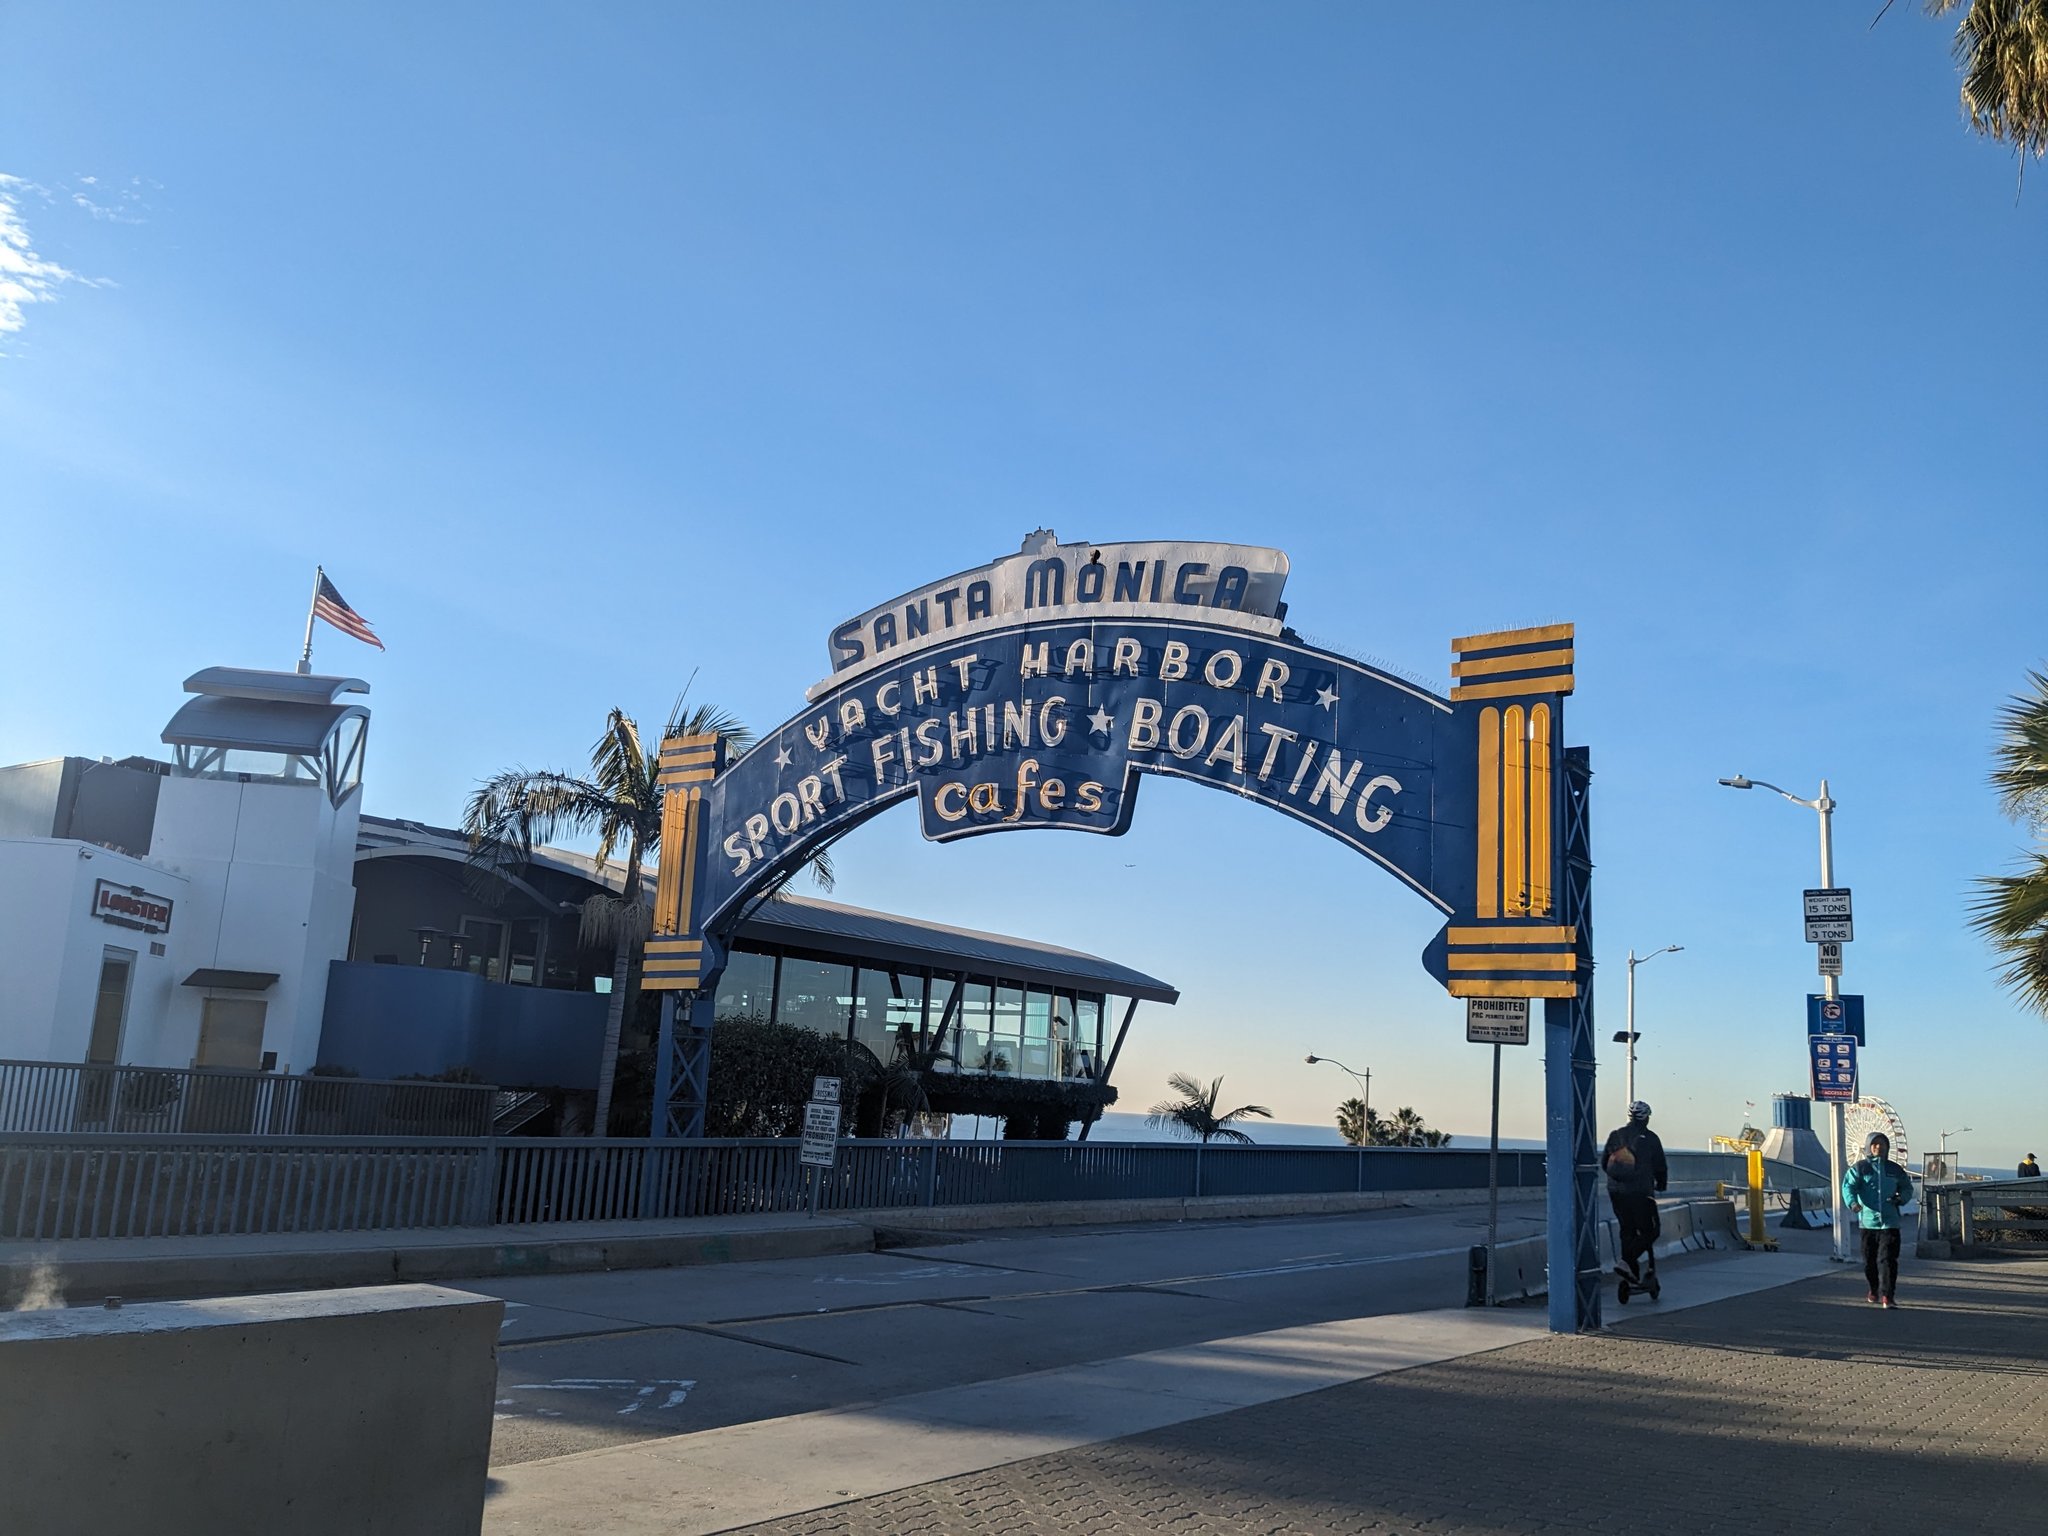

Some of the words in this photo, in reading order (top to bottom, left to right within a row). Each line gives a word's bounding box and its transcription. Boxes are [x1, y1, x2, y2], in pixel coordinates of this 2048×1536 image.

[833, 580, 991, 671] SANTA
[1025, 557, 1248, 609] MONICA
[805, 654, 977, 752] YACHT
[1021, 637, 1290, 703] HARBOR
[724, 755, 848, 877] SPORT
[872, 696, 1067, 785] FISHING
[1128, 698, 1402, 834] BOATING
[934, 759, 1104, 822] cafes
[1809, 905, 1819, 913] 15
[1823, 904, 1847, 913] TONS
[1812, 931, 1819, 939] 3
[1821, 930, 1847, 938] TONS
[1822, 945, 1838, 957] NO
[1472, 1000, 1525, 1012] PROHIBITED
[805, 1130, 835, 1142] PROHIBITED
